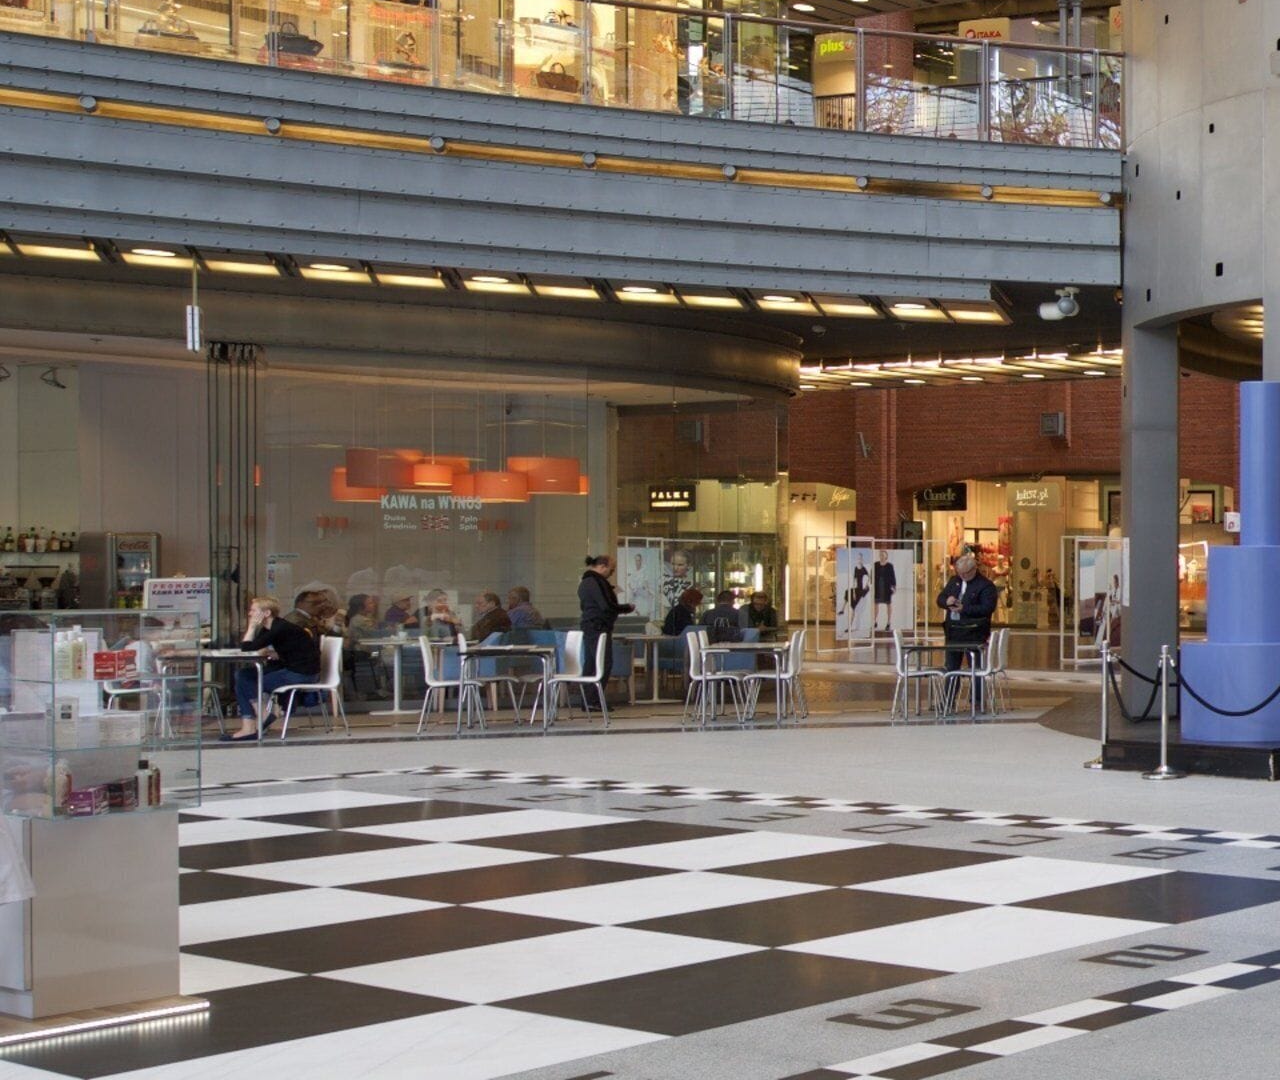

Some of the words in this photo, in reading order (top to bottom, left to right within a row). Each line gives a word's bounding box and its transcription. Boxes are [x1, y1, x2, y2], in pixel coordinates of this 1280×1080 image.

[976, 30, 1002, 39] ITAKA
[820, 39, 845, 56] plus
[381, 494, 418, 510] KAWA
[420, 497, 436, 510] na
[438, 494, 482, 510] WYNOS
[1079, 943, 1210, 969] 2
[825, 998, 982, 1031] 3
